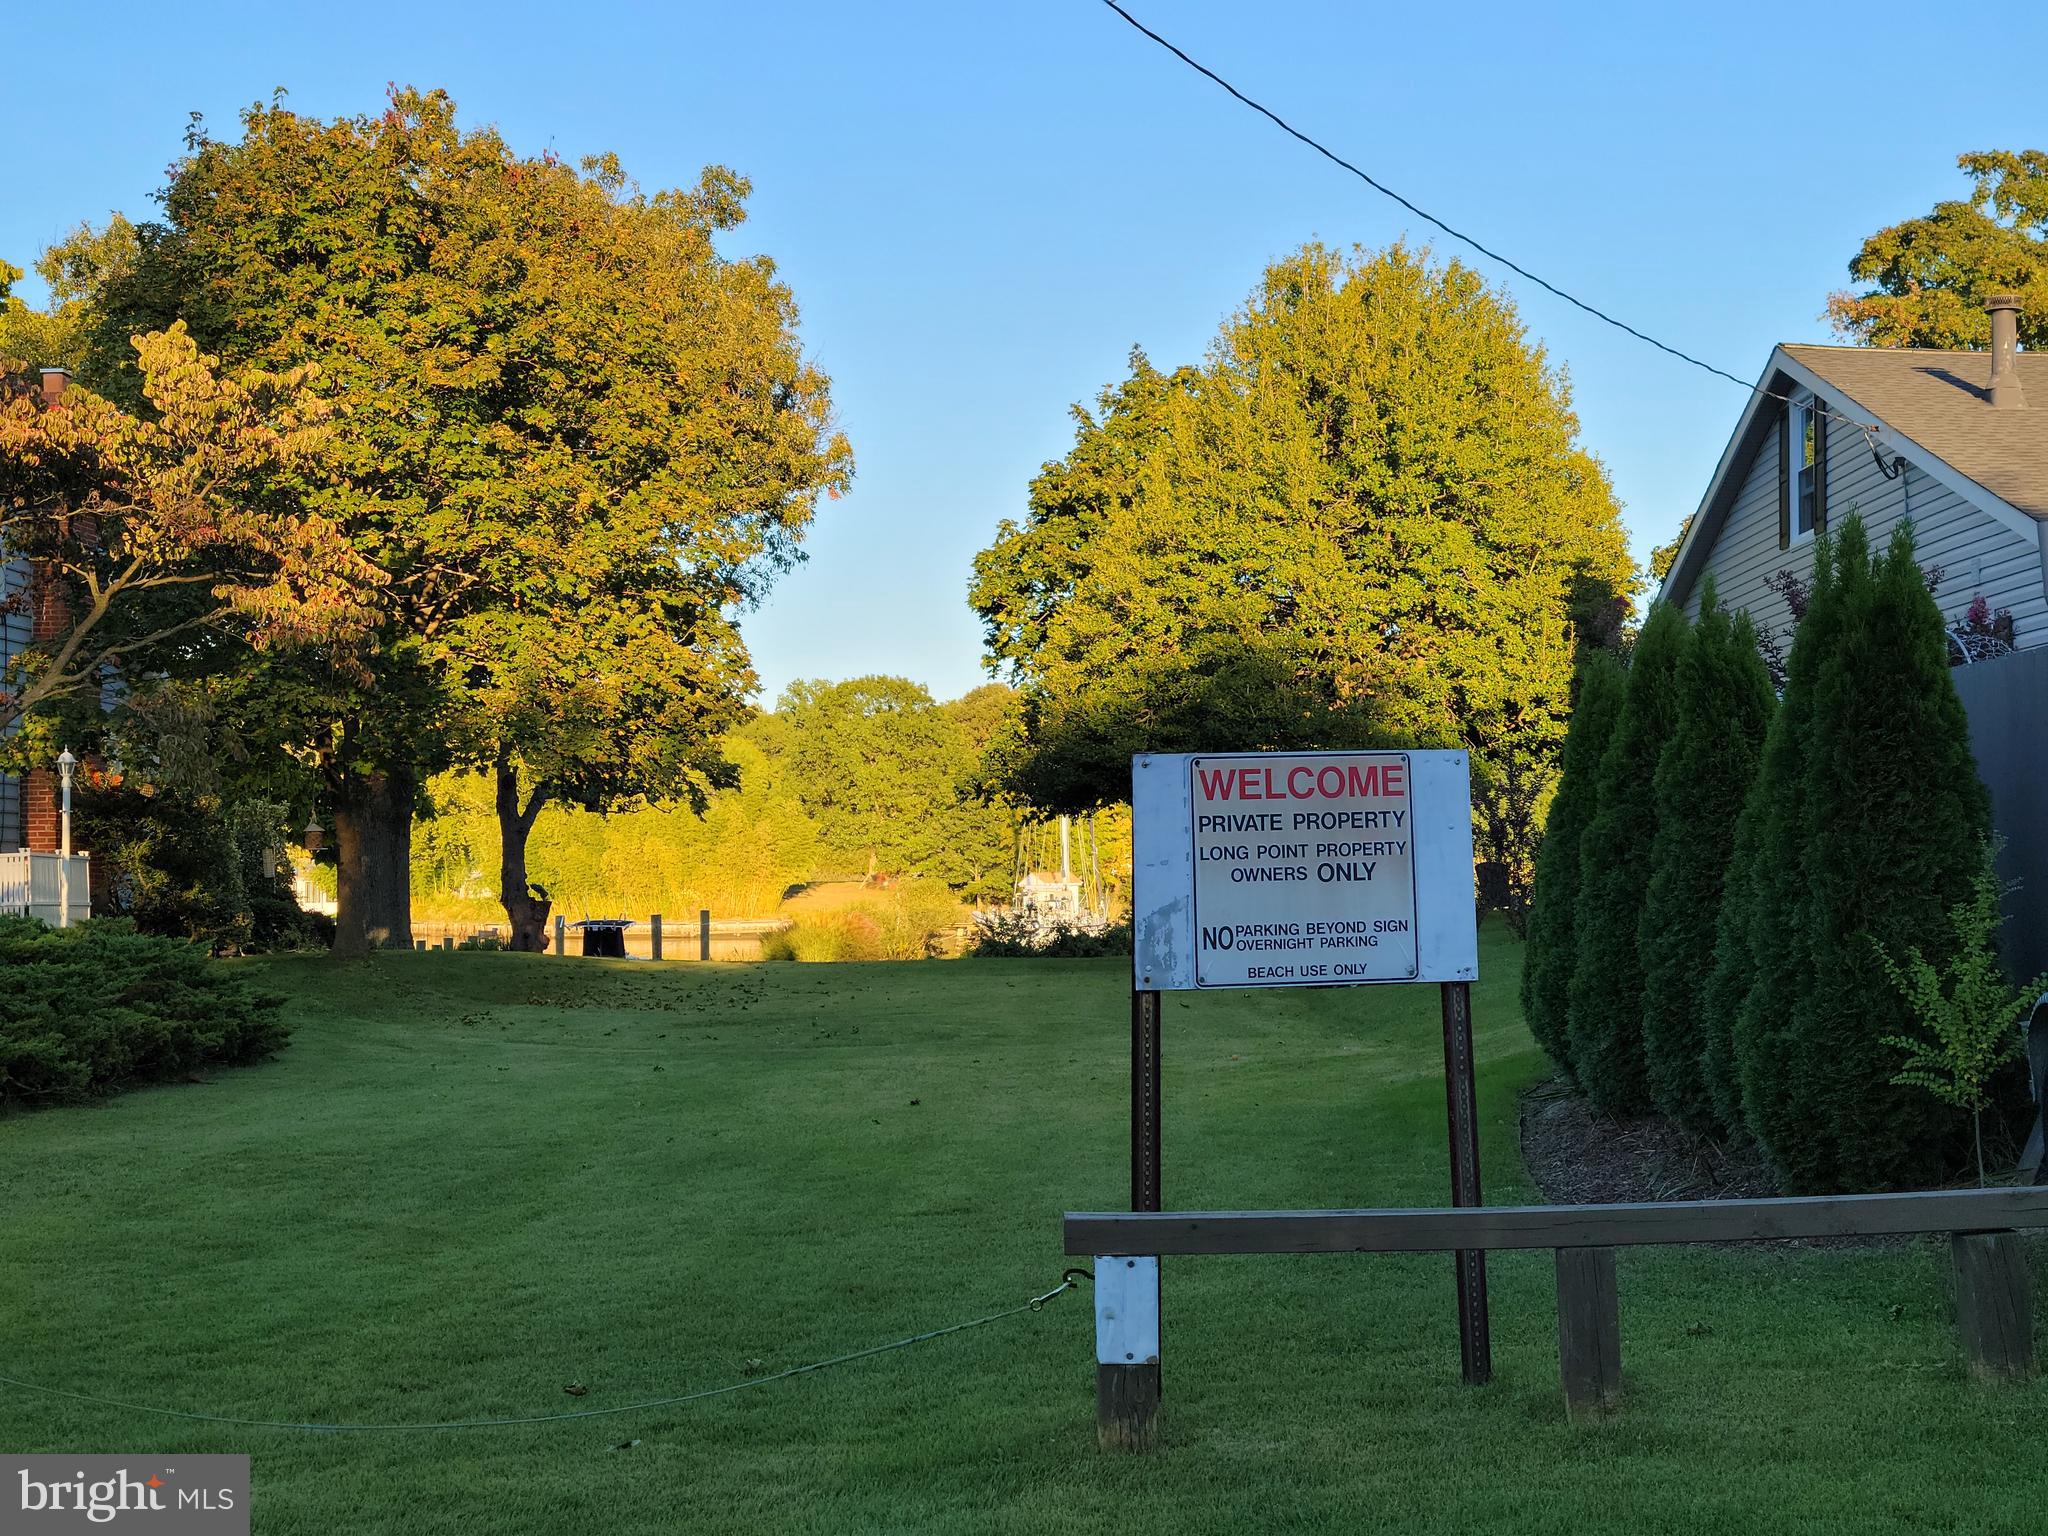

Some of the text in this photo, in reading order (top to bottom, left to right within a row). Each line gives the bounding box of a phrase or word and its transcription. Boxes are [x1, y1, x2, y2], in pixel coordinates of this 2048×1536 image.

[1199, 765, 1405, 801] WELCOME
[1199, 810, 1406, 833] PRIVATE PROPERTY
[1200, 841, 1406, 861] LONG POINT PROPERTY
[1231, 862, 1376, 883] OWNERS ONLY
[1202, 919, 1409, 951] NO PARKING BEYOND SIGN
[1236, 936, 1378, 951] OVERNIGHT PARKING
[1248, 963, 1367, 979] BEACH USE ONLY
